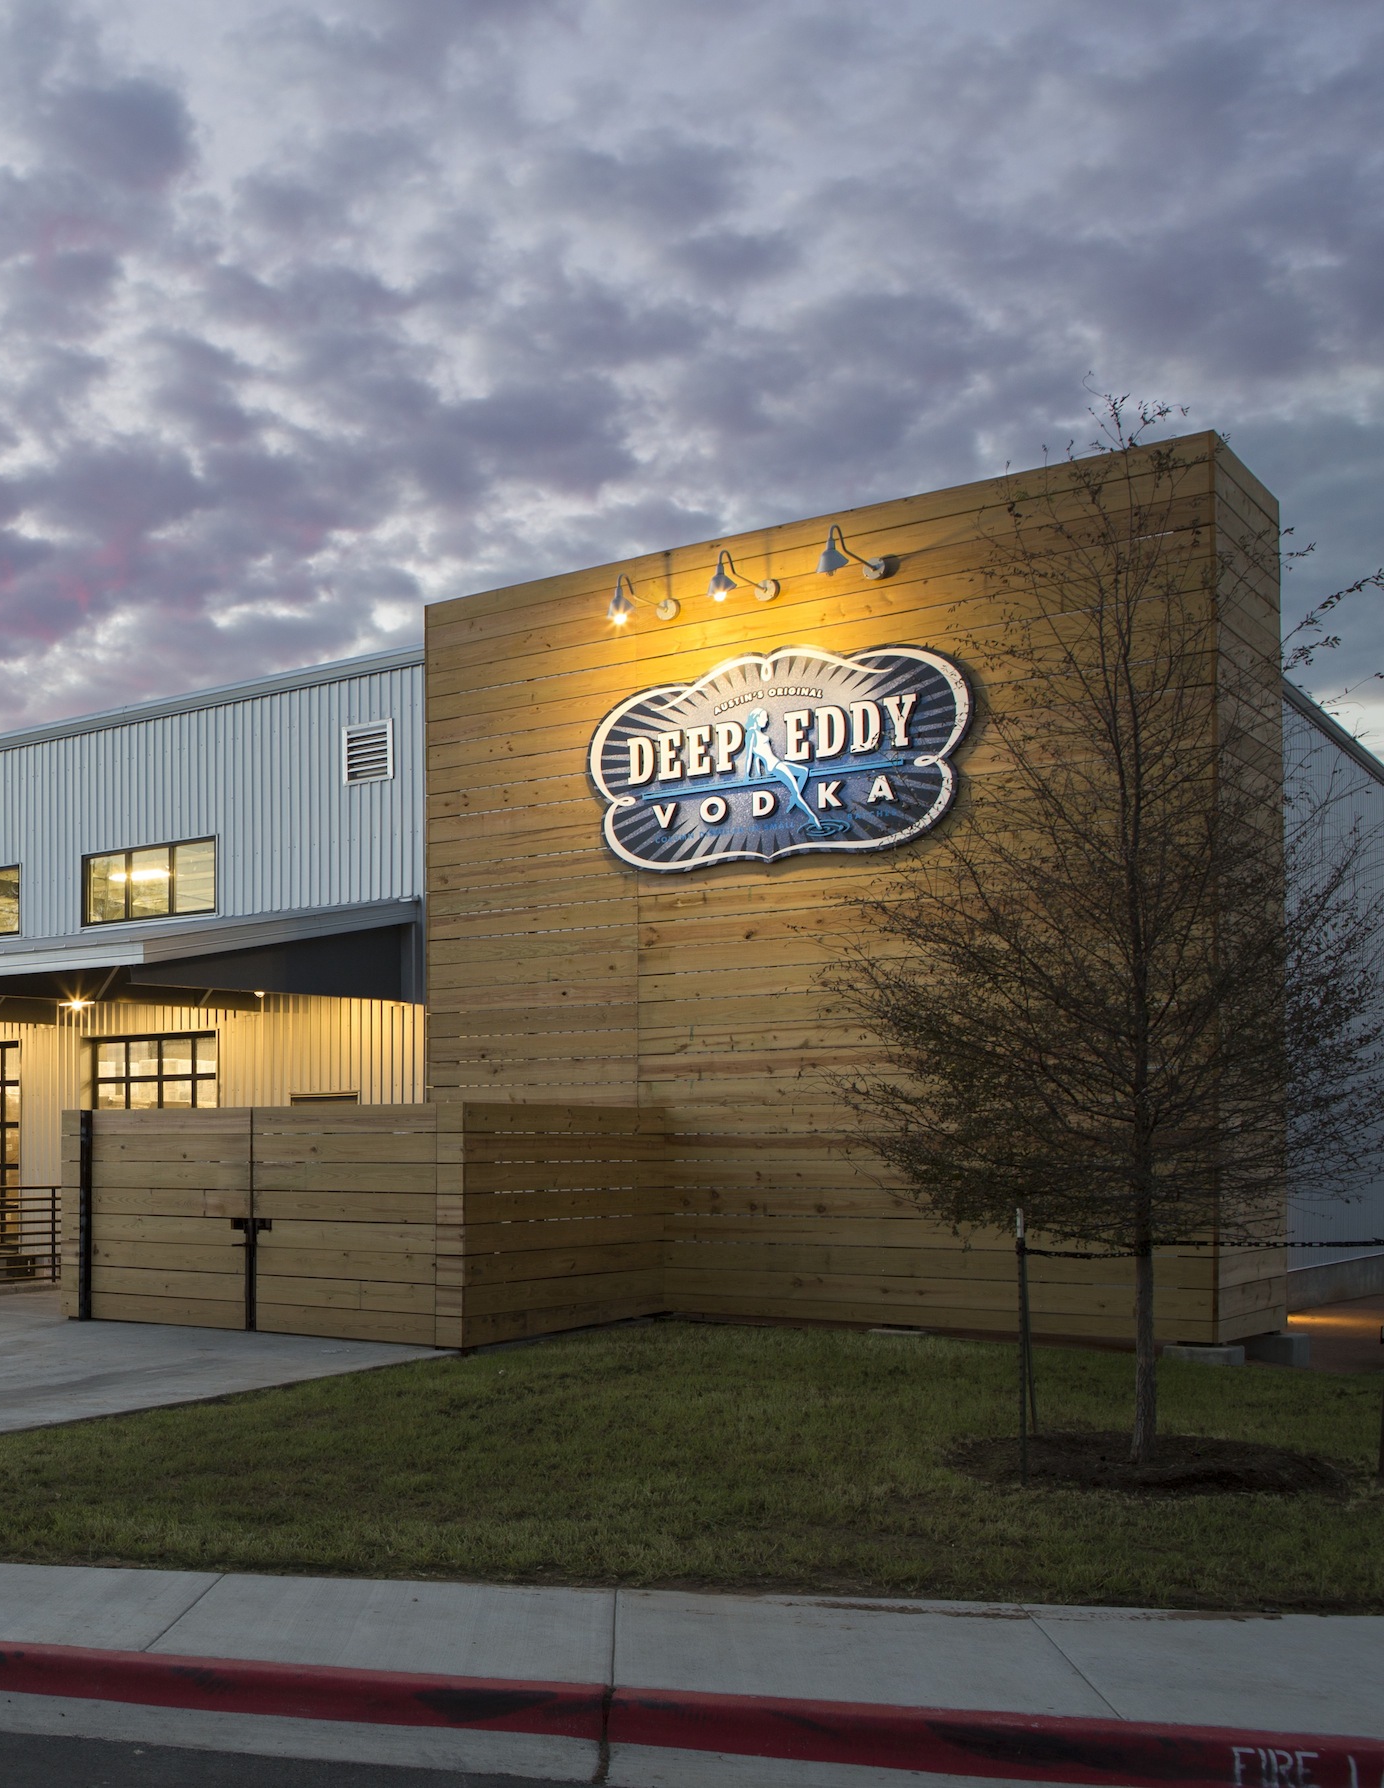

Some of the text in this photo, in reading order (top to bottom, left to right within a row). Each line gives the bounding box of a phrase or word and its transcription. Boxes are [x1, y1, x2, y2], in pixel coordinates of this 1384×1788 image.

[714, 686, 823, 716] AUSTIN'S ORIGINAL
[626, 693, 917, 786] DEEP EDDY
[653, 774, 899, 829] VODKA
[763, 821, 796, 832] SMALL
[1231, 1746, 1321, 1788] FIRE
